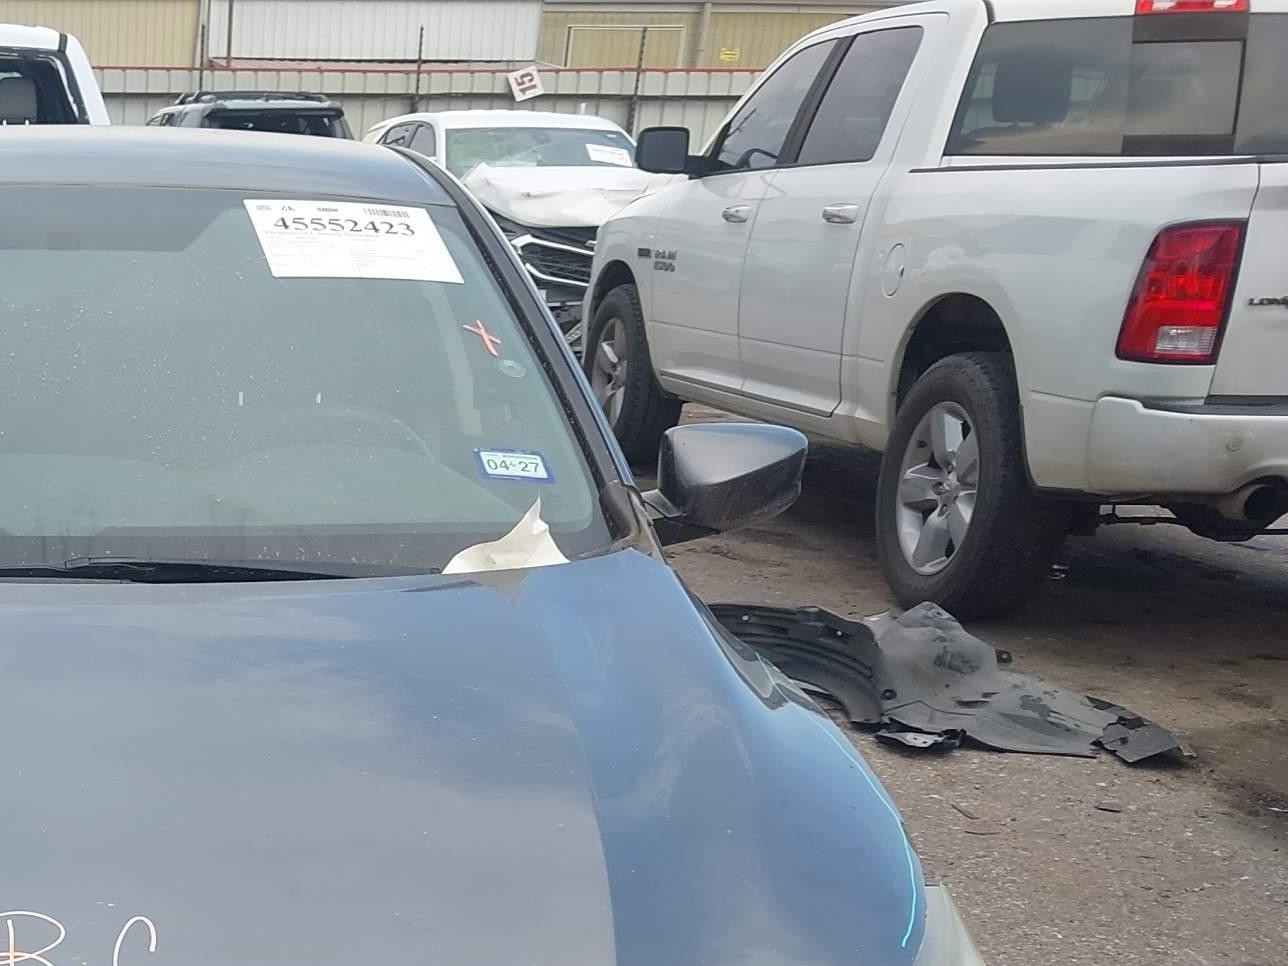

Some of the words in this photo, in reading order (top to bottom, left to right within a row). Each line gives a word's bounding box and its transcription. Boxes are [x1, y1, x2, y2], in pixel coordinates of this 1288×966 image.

[514, 72, 537, 96] 15
[274, 216, 416, 237] 45552423
[486, 458, 510, 471] 04
[518, 460, 540, 473] 27
